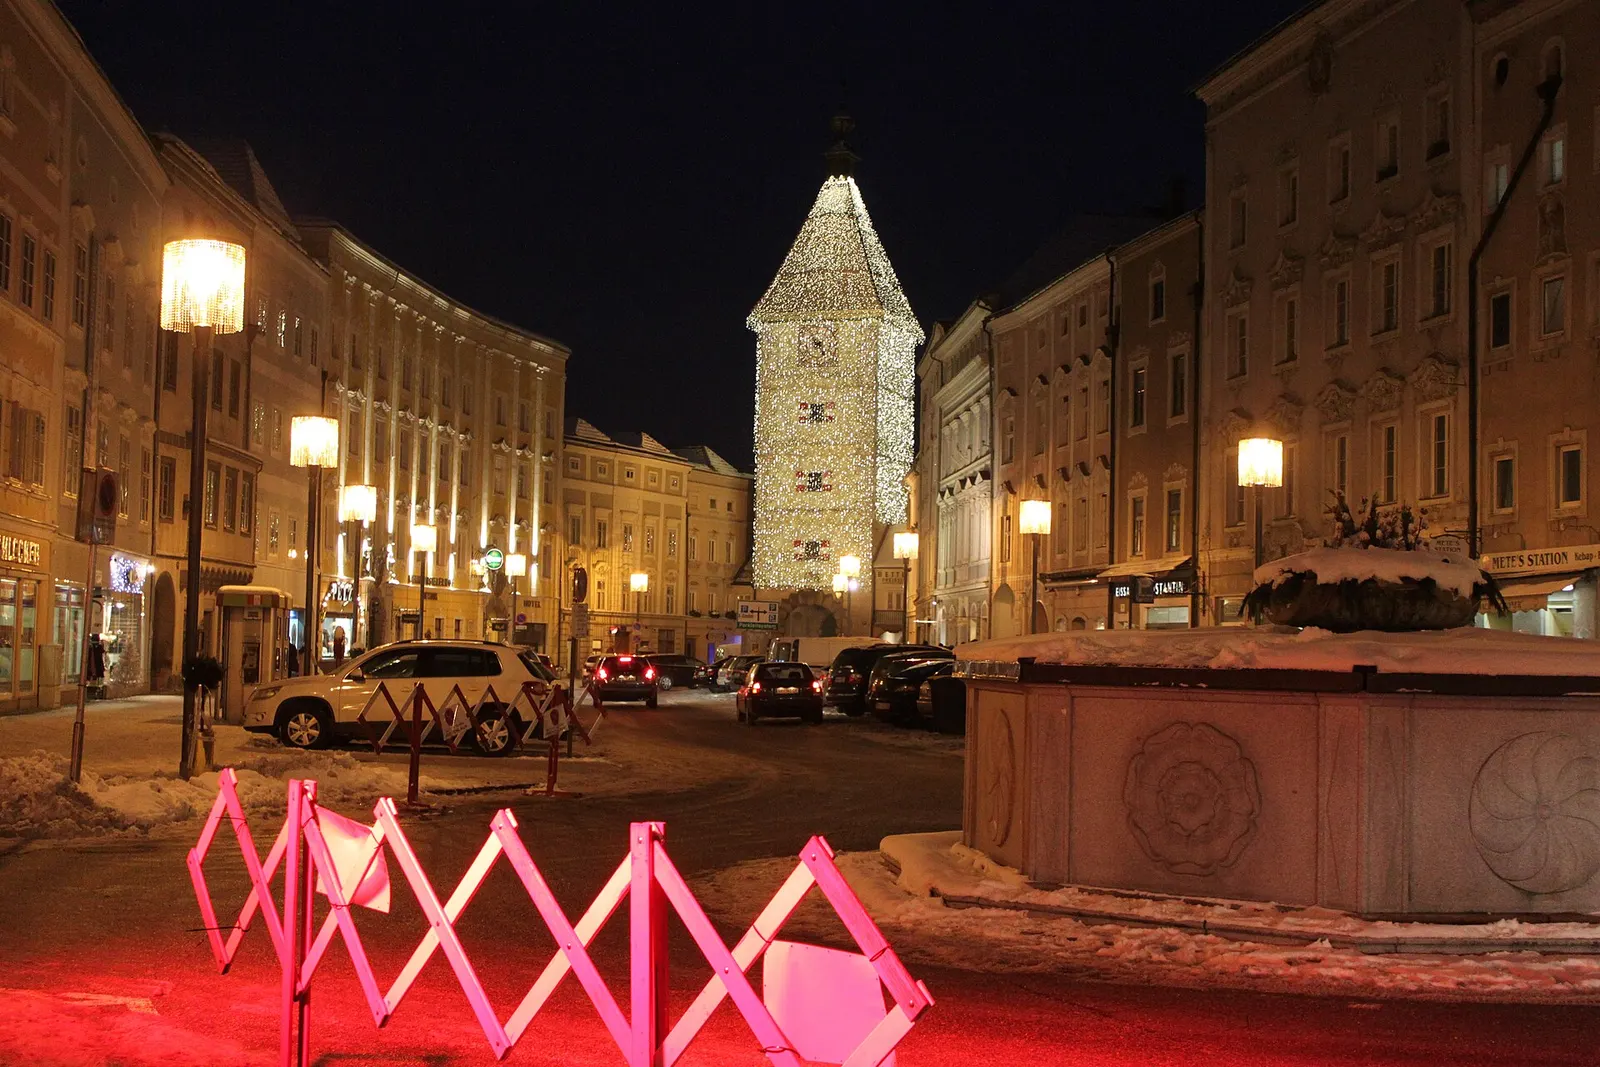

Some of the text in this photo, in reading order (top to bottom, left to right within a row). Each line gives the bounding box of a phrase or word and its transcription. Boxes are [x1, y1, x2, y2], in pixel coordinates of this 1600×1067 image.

[0, 535, 39, 565] HLECKER
[1492, 555, 1524, 570] METE'S
[1528, 551, 1569, 567] STATION
[524, 600, 541, 608] HOTEL
